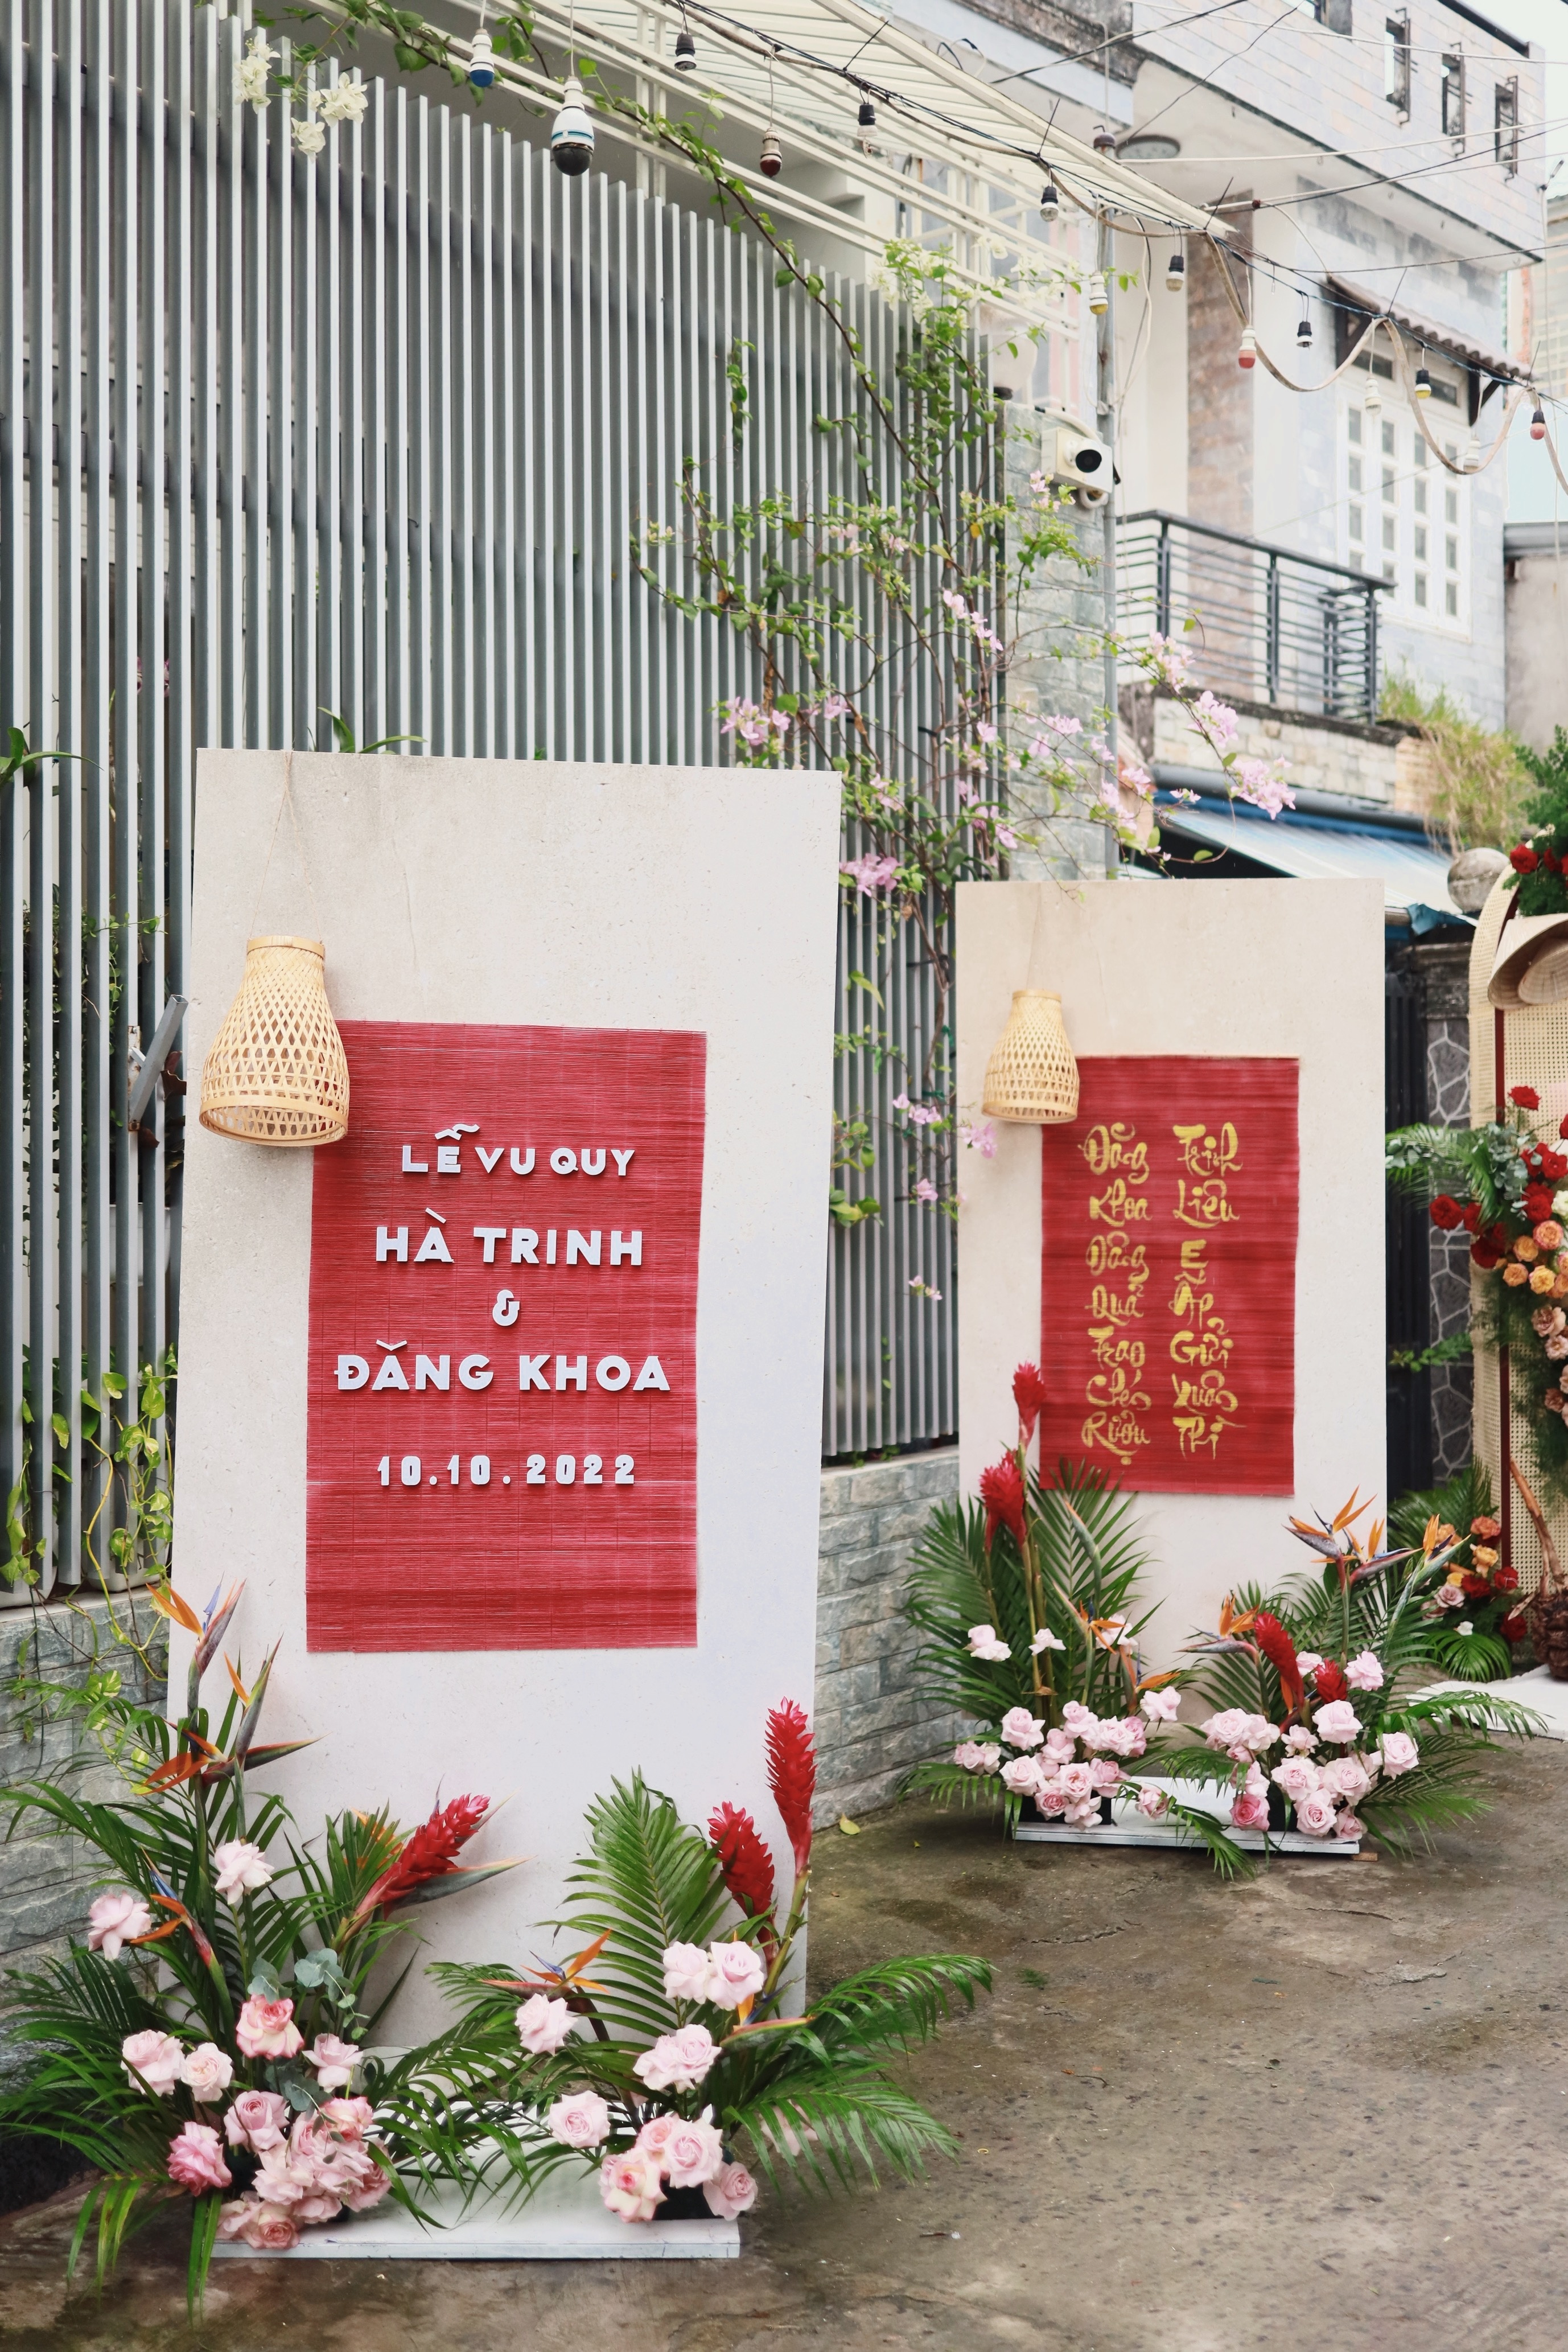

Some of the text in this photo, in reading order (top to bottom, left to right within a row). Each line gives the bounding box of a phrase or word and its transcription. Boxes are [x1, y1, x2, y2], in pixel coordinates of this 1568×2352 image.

[401, 1124, 635, 1176] LỄ VU QUY
[1089, 1178, 1153, 1228] Khoa
[376, 1207, 643, 1266] HÀ TRINH
[492, 1289, 520, 1327] &
[334, 1339, 670, 1391] ĐĂNG KHOA
[1087, 1326, 1146, 1370] Trao
[1086, 1367, 1152, 1411] Chén
[377, 1454, 635, 1487] 10.10.2022
